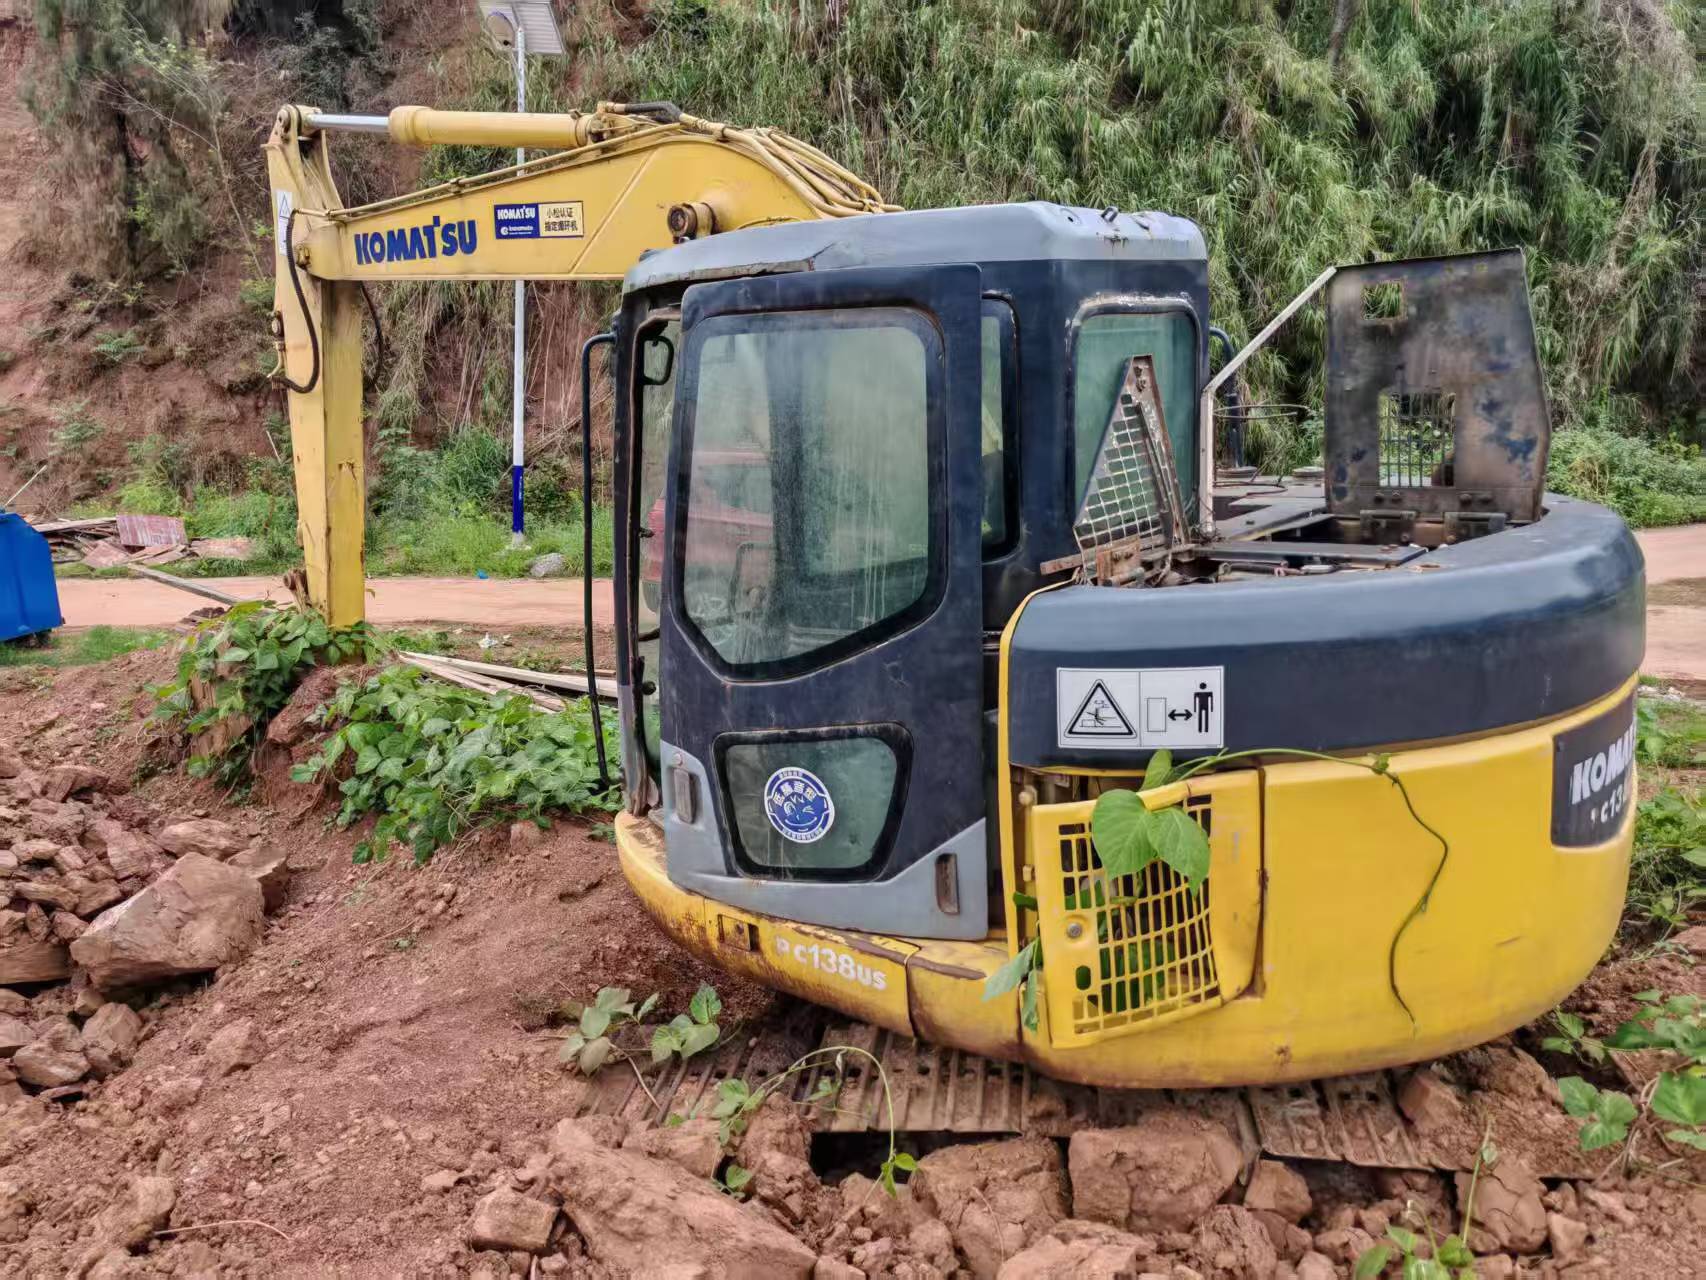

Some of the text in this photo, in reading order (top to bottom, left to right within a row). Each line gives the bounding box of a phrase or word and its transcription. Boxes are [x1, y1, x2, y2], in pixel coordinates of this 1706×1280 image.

[497, 205, 536, 220] KOMATSU
[354, 216, 478, 265] KOMATSU
[1570, 722, 1635, 805] KOMA
